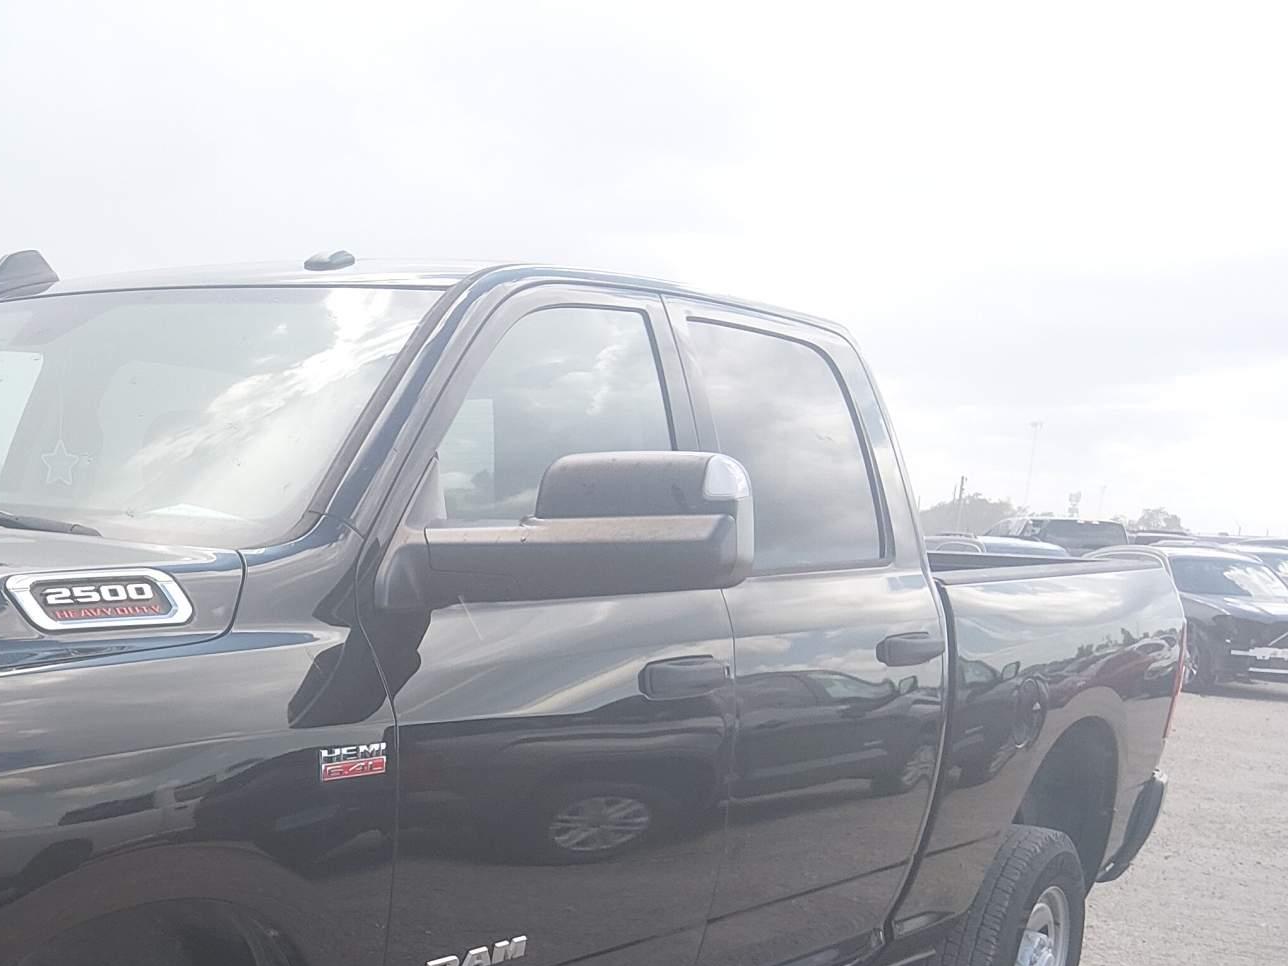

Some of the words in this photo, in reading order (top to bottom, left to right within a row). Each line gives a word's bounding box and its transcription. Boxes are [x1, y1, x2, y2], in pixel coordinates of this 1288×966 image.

[46, 583, 154, 605] 2500
[55, 608, 113, 620] HEAVY
[114, 604, 161, 616] DUTY
[320, 742, 387, 762] HEMI
